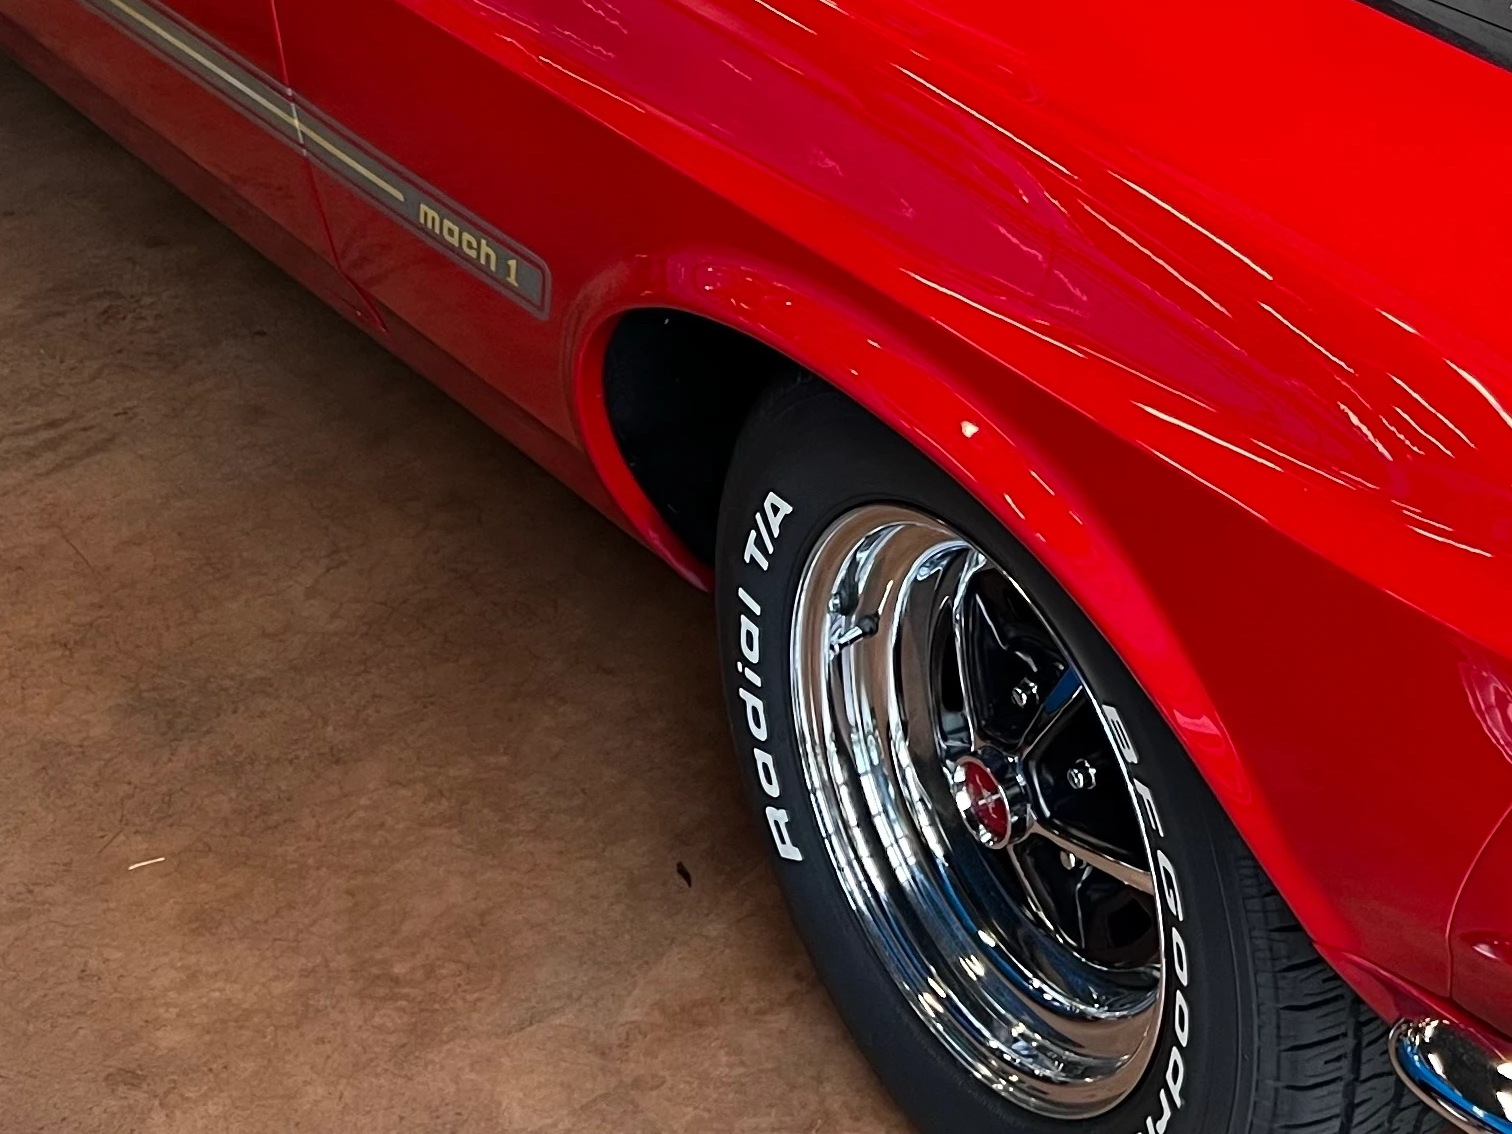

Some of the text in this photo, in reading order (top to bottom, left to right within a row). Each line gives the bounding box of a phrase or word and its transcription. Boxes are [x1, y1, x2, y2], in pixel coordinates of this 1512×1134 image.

[419, 203, 519, 287] mach 1
[738, 491, 803, 862] Radial T/A
